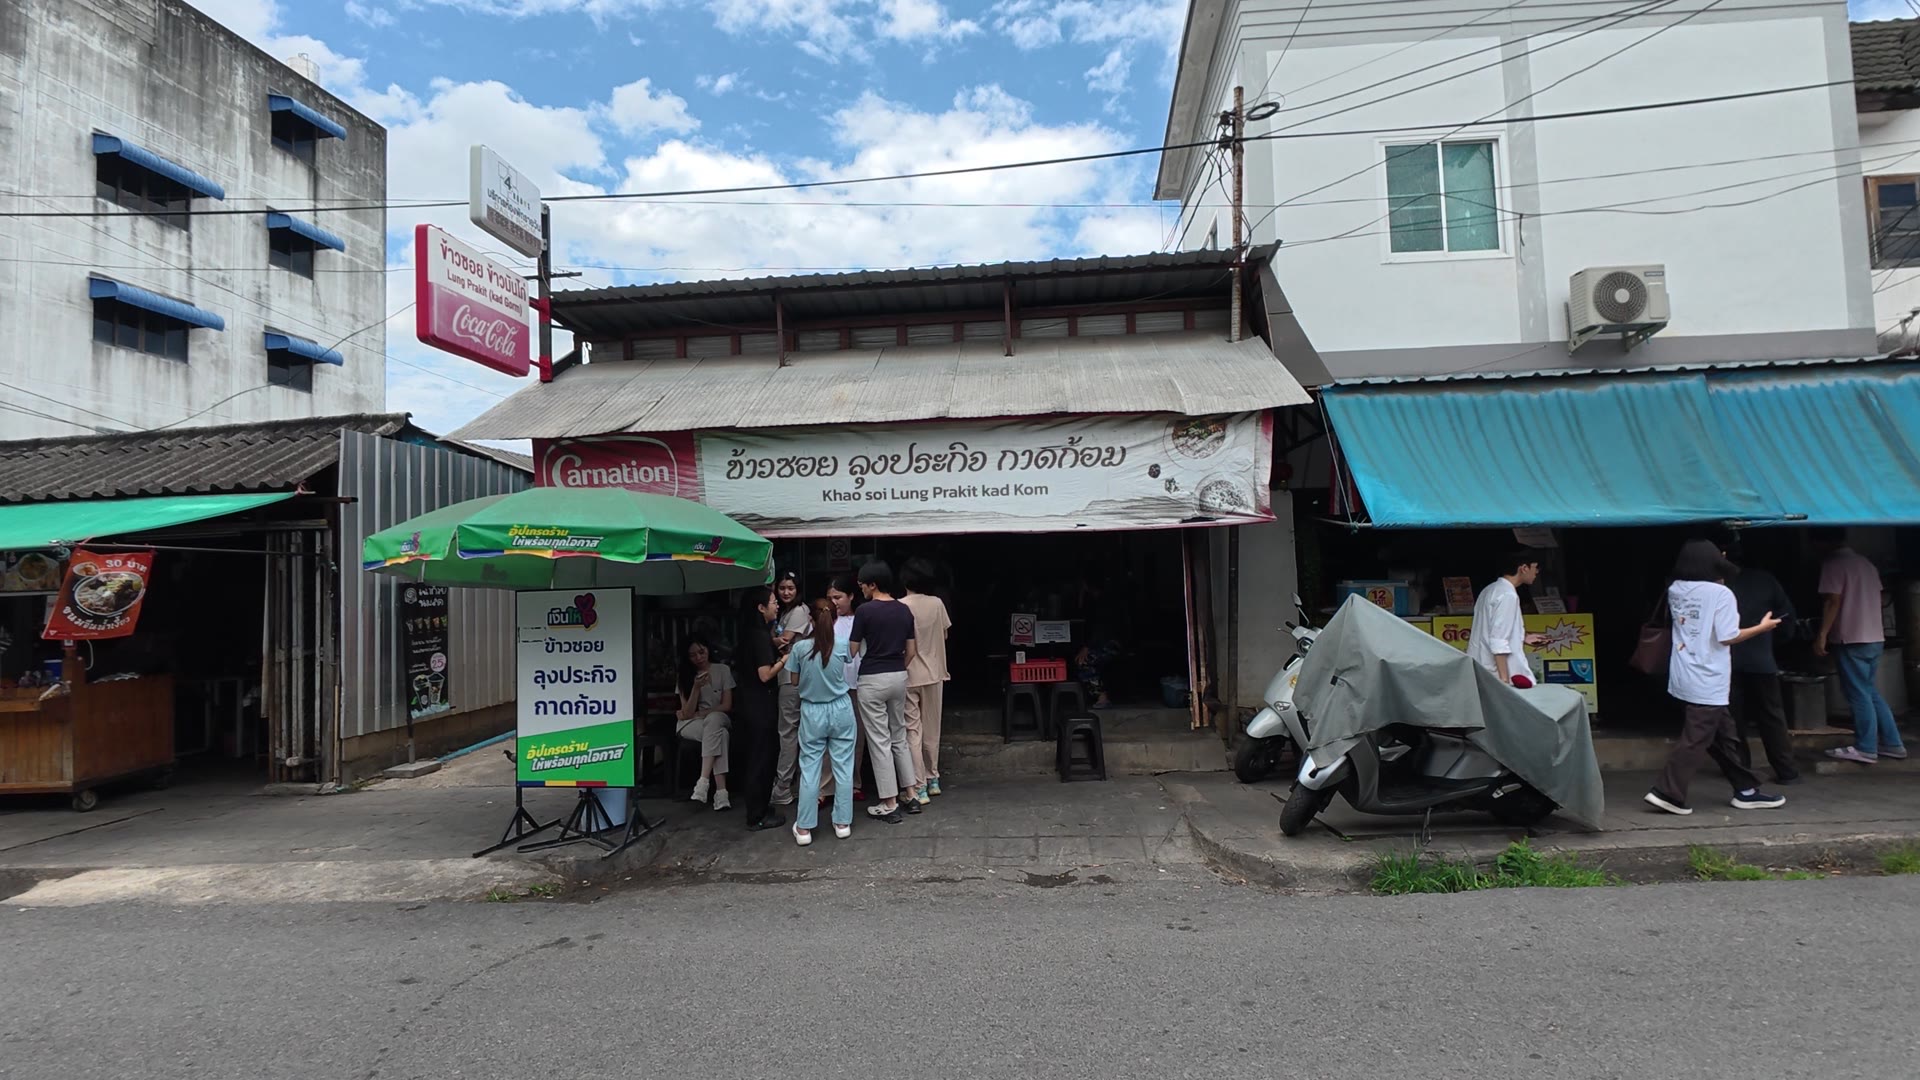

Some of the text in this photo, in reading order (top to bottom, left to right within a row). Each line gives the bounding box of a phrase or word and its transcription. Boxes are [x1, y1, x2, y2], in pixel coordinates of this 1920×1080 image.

[503, 176, 513, 191] 4
[440, 238, 484, 278] ข้าวซอย
[447, 268, 466, 289] Lung
[467, 279, 488, 298] Prakit
[489, 289, 503, 304] (kad
[452, 304, 519, 358] Coca-Cola
[551, 454, 670, 488] Carnation
[726, 448, 839, 480] ข้าวซอย
[848, 442, 987, 490] ลุงประกิจ
[822, 483, 1049, 503] Khao soi Lung Prakit kad Kom
[512, 535, 602, 549] ให้พร้อมทุกโอกาส
[1371, 590, 1386, 600] 12
[544, 636, 605, 654] ข้าวซอย
[431, 659, 444, 669] 25
[533, 664, 618, 691] ลุงประกิจ
[534, 693, 617, 716] กาดก้อม
[526, 740, 589, 760] อัปเกรดร้าน
[531, 746, 625, 769] ให้พร้อมทุกโอกาส
